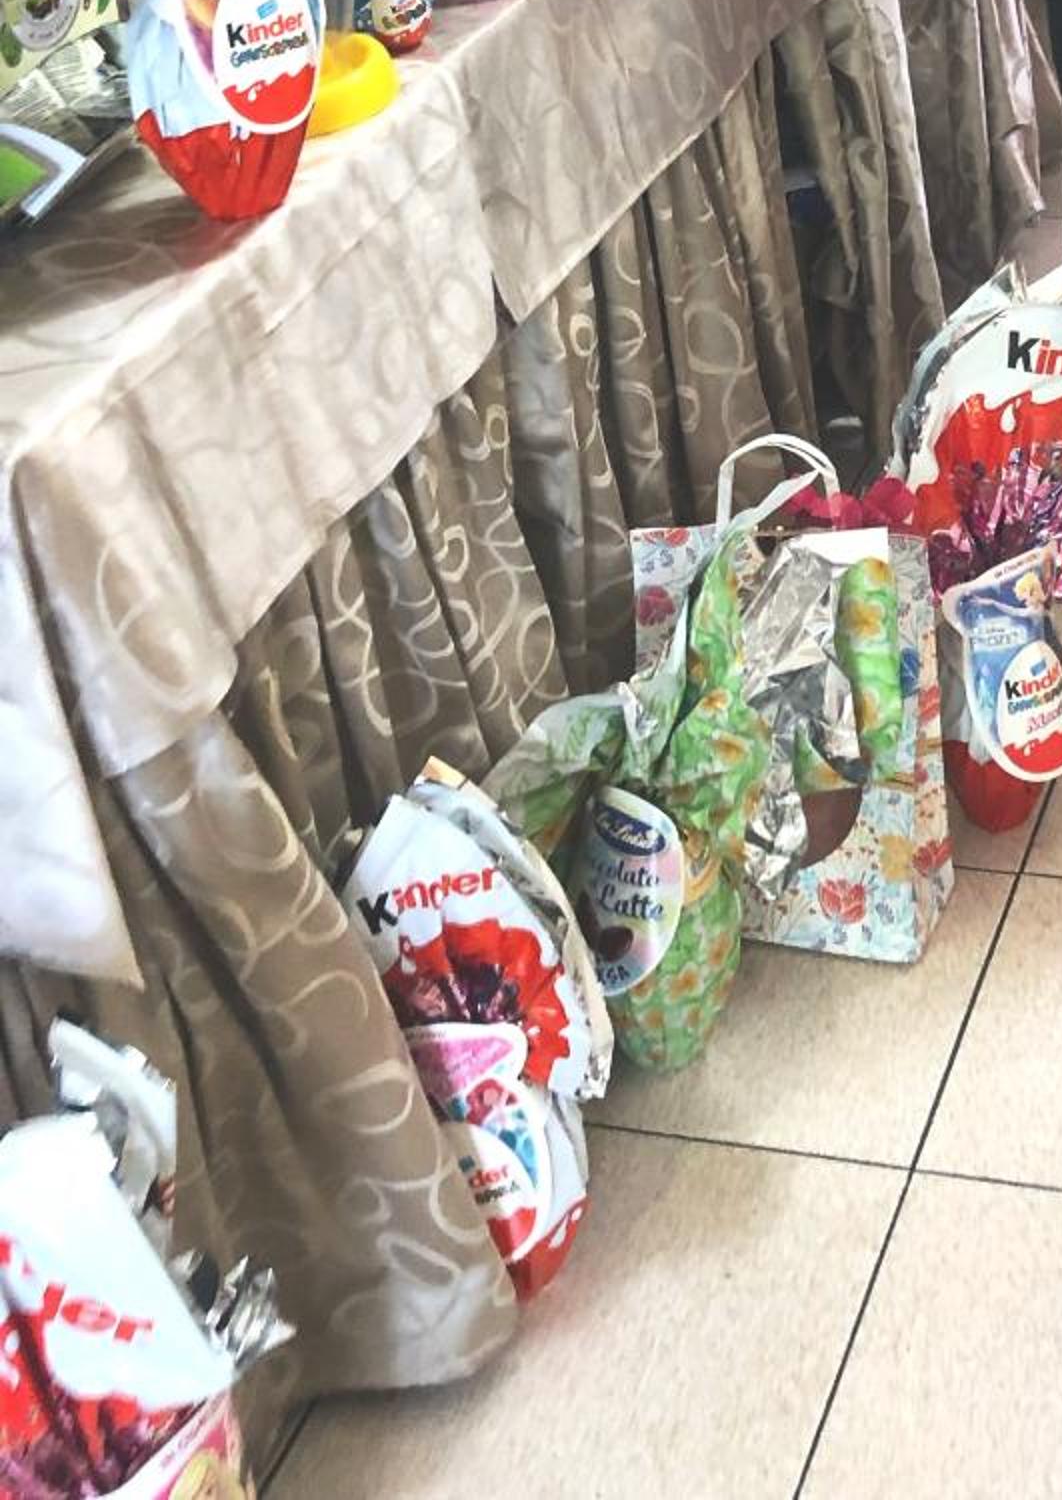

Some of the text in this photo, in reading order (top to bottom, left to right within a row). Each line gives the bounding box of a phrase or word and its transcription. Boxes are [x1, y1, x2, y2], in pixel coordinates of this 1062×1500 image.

[226, 10, 305, 50] Kinder
[1004, 658, 1061, 700] Kind
[356, 866, 499, 936] Kinder
